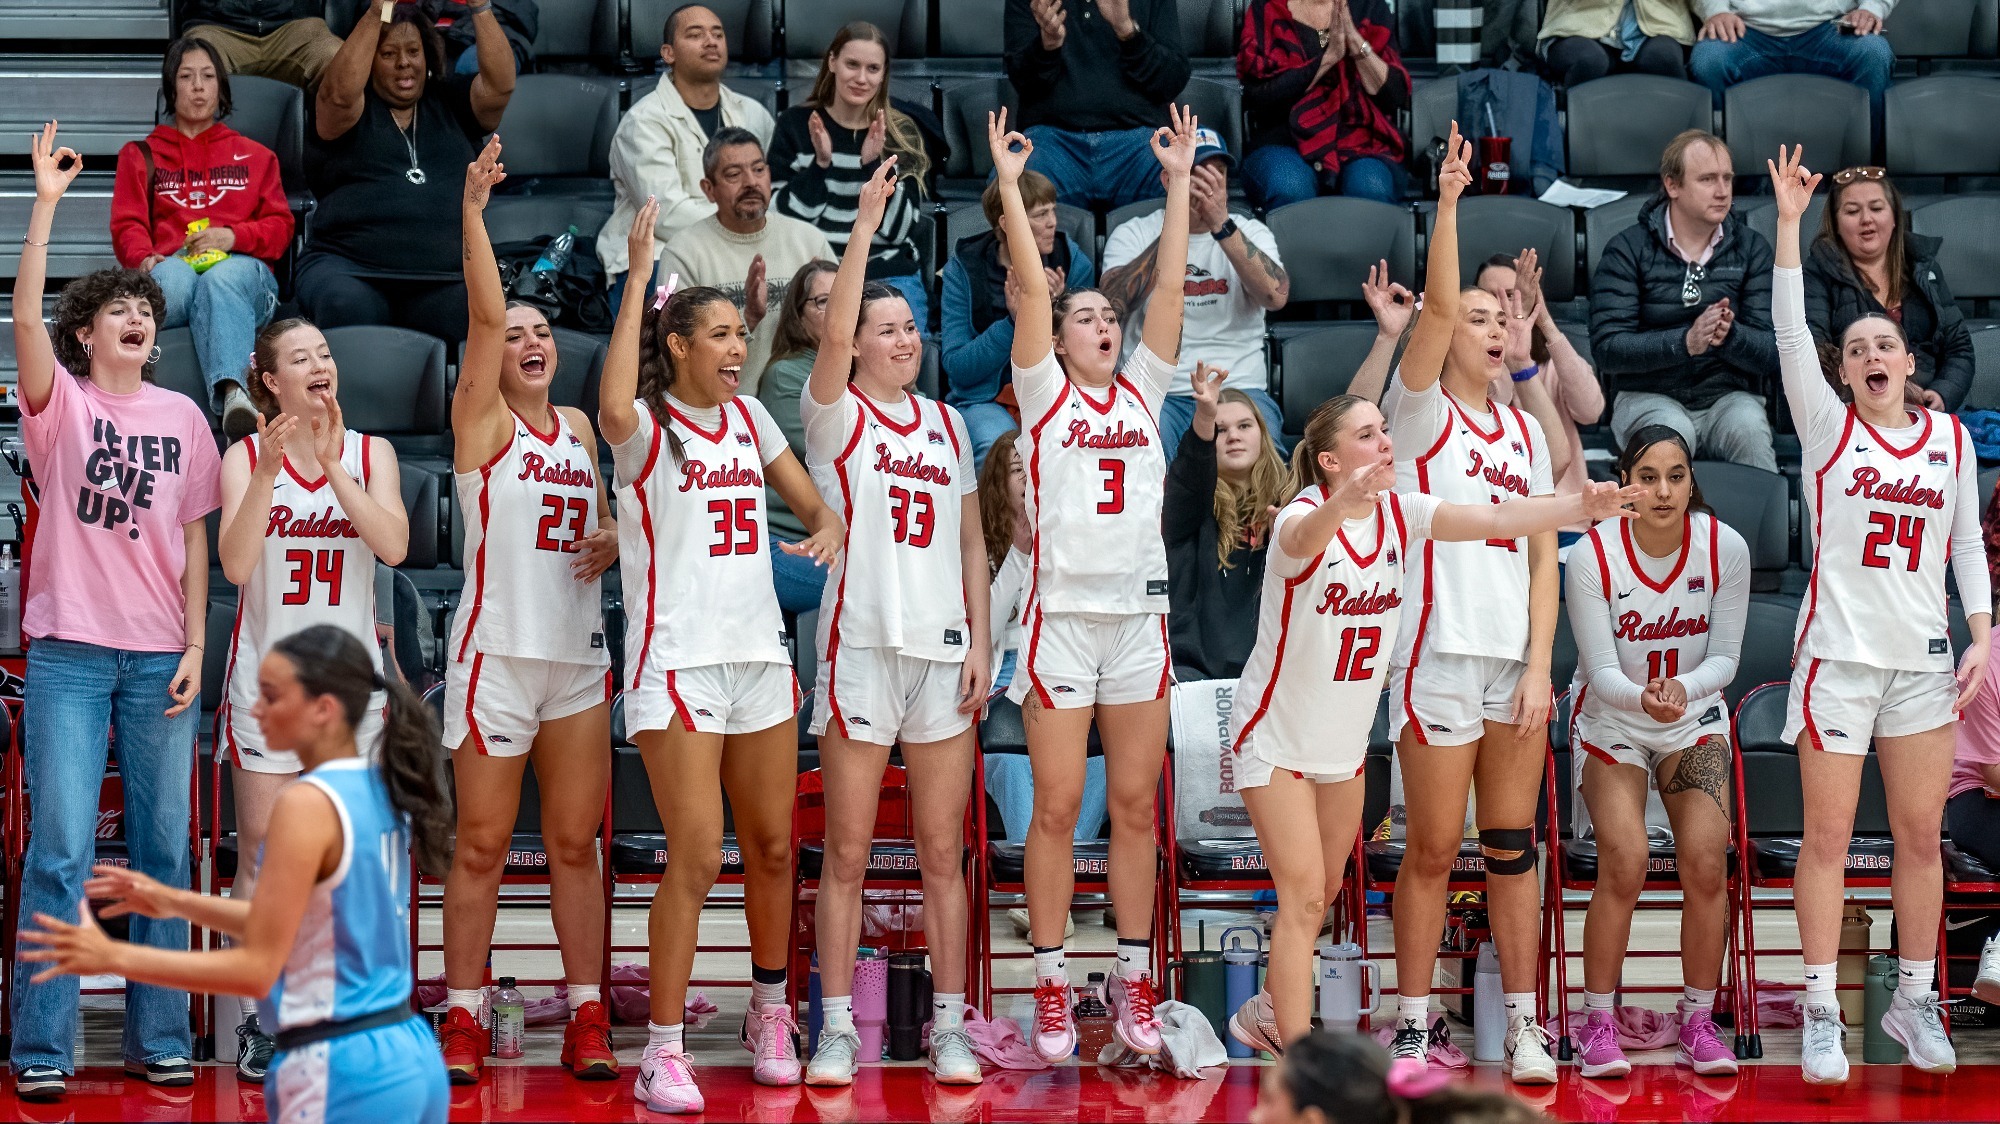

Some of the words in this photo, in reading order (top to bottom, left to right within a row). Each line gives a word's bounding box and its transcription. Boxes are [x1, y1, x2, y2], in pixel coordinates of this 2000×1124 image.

[1062, 418, 1149, 449] Raiders
[517, 451, 594, 489] Raiders
[873, 442, 951, 486] Raiders
[1096, 458, 1126, 515] 3
[1844, 465, 1945, 510] Raiders
[265, 504, 360, 538] Raider
[535, 493, 589, 554] 23
[707, 498, 759, 558] 35
[888, 485, 936, 549] 33
[1861, 510, 1926, 573] 24
[282, 548, 345, 606] 34
[1315, 581, 1402, 617] Raides
[1613, 606, 1710, 643] Raiders
[1332, 625, 1382, 682] 12
[1646, 647, 1679, 685] 11
[866, 854, 920, 870] IDER
[1845, 854, 1891, 869] DERS
